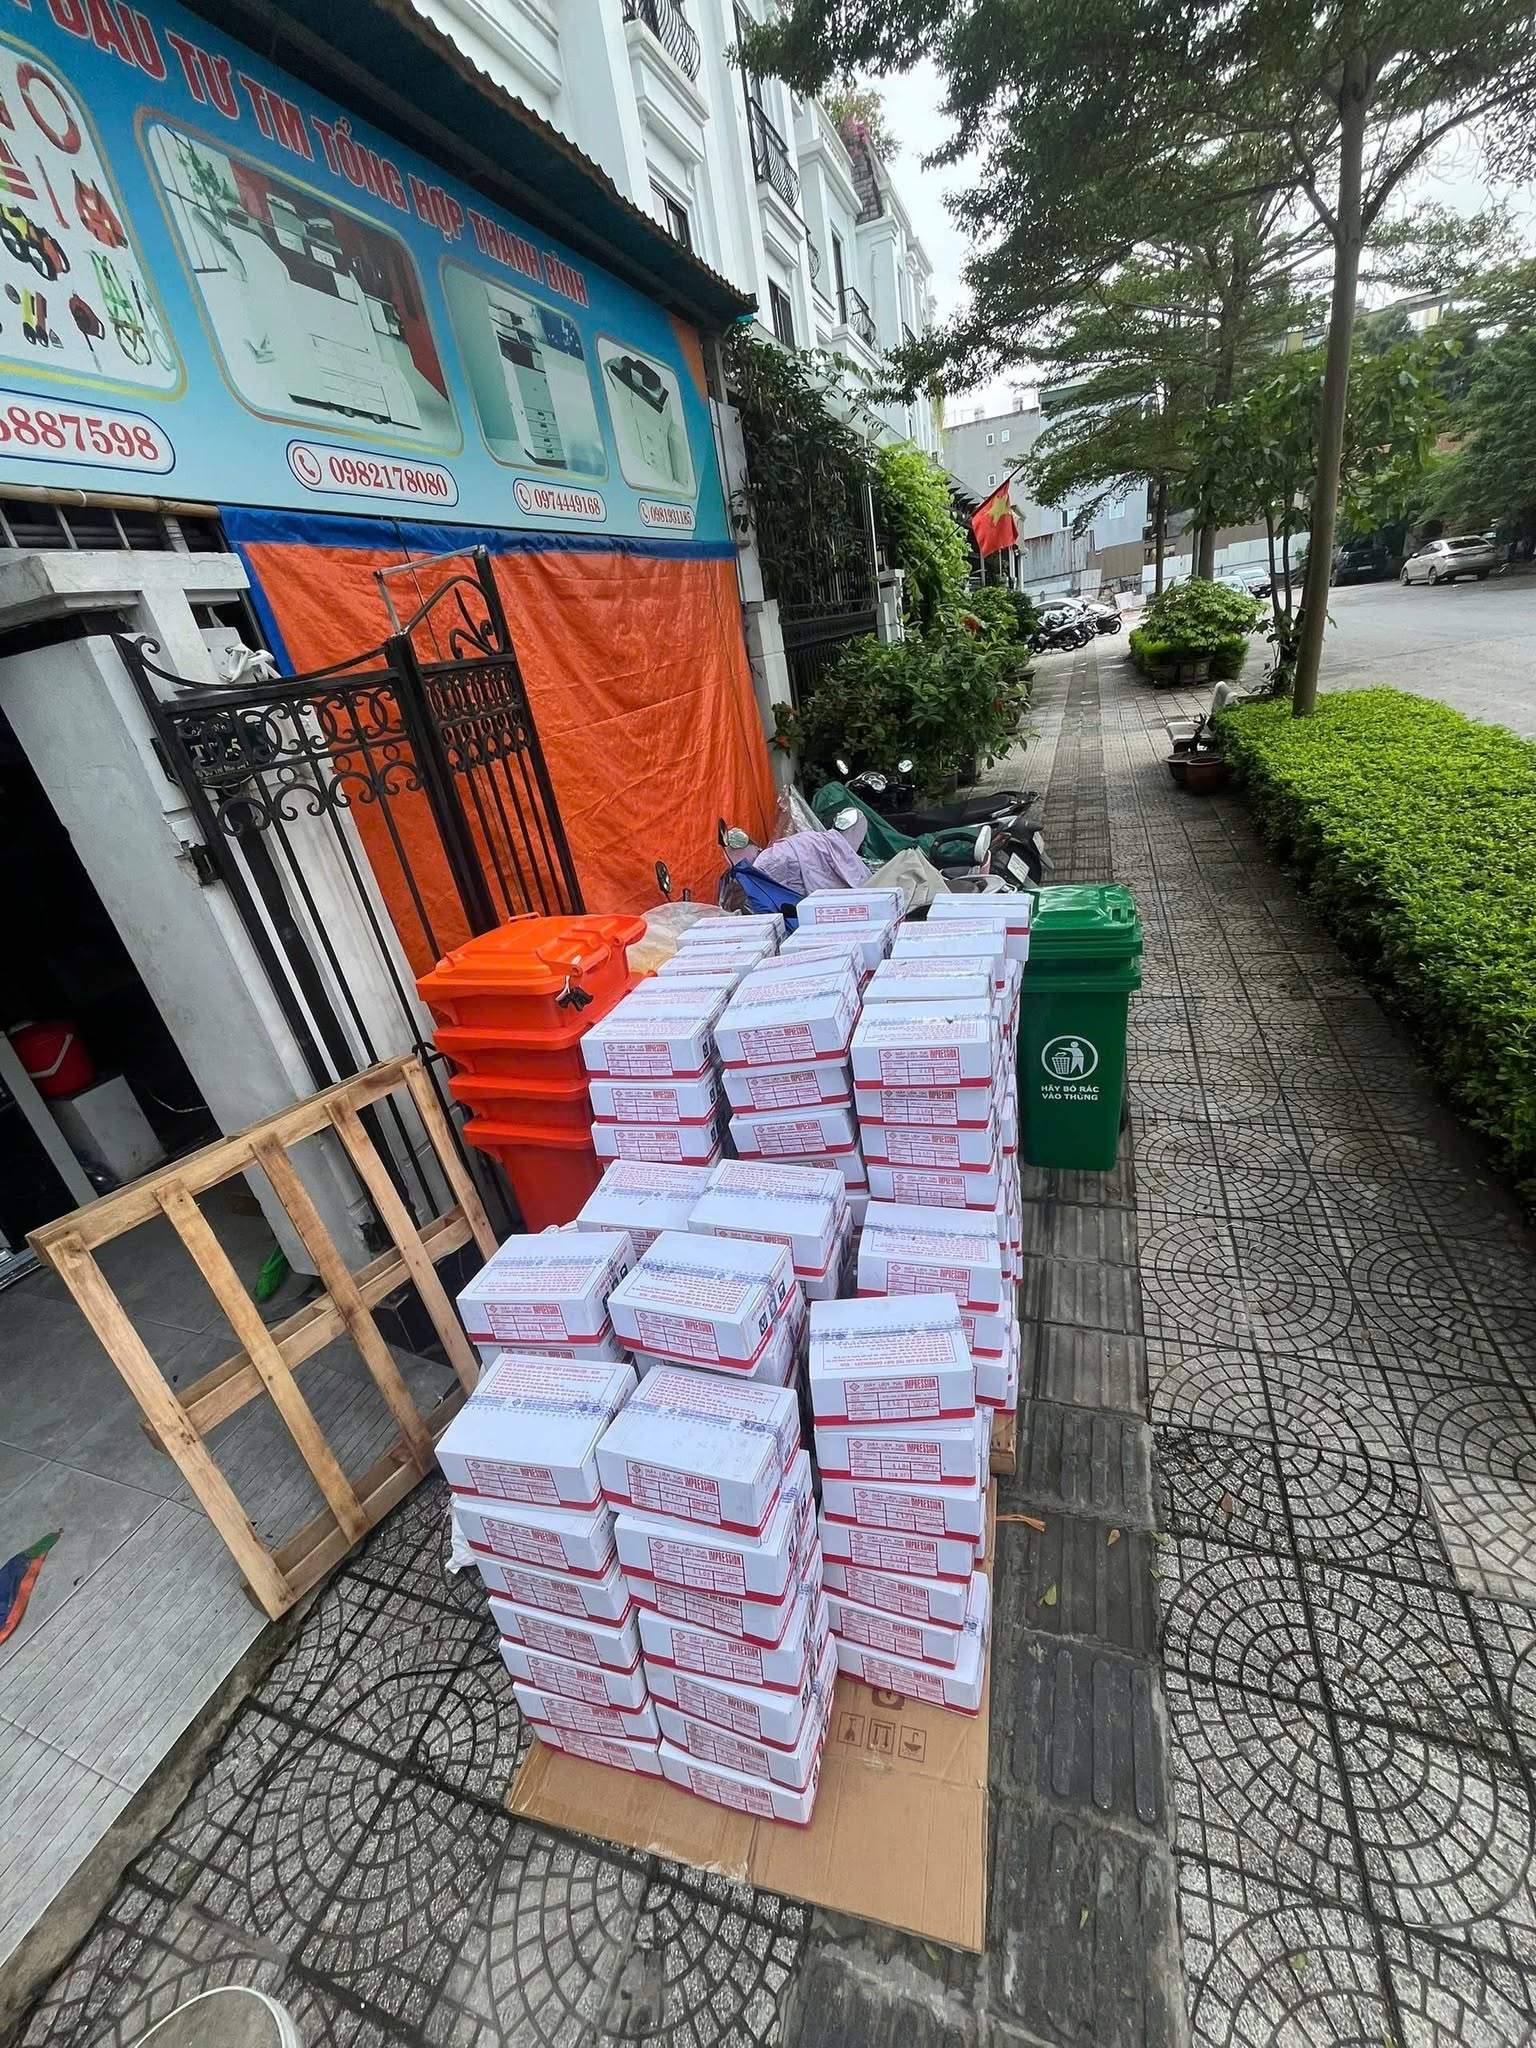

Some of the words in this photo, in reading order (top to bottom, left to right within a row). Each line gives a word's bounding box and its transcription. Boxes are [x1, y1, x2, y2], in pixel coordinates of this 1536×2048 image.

[165, 28, 240, 120] TƯ
[238, 71, 315, 162] TM
[311, 115, 410, 214] TỔNG
[408, 173, 464, 243] HỢP
[467, 208, 544, 285] THANH
[542, 249, 589, 308] BÌNH
[329, 456, 448, 497] 0982178080
[534, 488, 600, 516] 0974449168
[1041, 1084, 1060, 1092] HÃY
[1079, 1085, 1100, 1093] RÁC
[1041, 1092, 1062, 1100] VÀO
[1064, 1093, 1098, 1101] THÙNG
[904, 1378, 936, 1390] IMPRESSION
[906, 1442, 938, 1454] IMPRESSION
[684, 1476, 716, 1493] IMPRESSION
[910, 1496, 942, 1510] IMPRESSION
[708, 1550, 741, 1566] IMPRESSION
